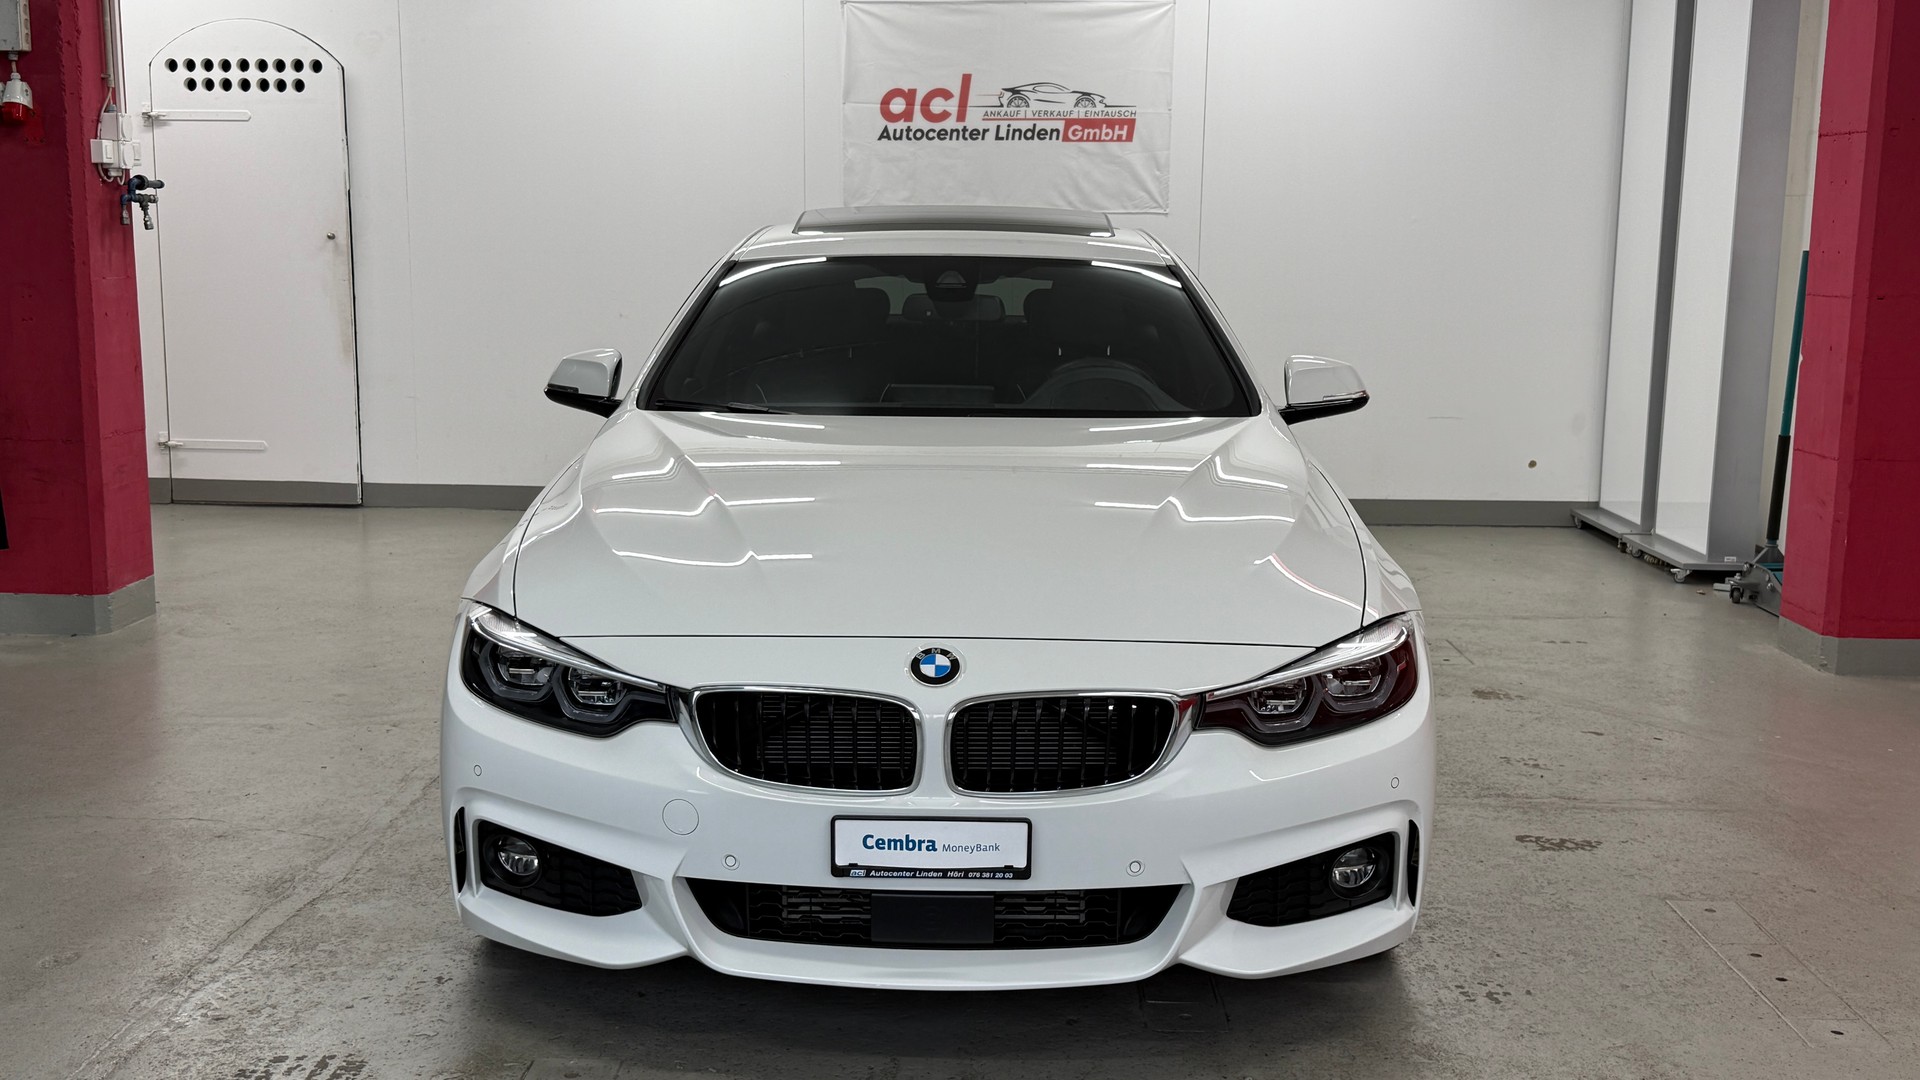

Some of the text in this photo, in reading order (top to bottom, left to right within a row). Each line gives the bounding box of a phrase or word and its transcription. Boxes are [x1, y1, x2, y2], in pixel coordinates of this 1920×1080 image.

[880, 73, 972, 123] acl
[877, 123, 1128, 141] Autocenter Linden GmbH
[916, 648, 957, 660] BMW
[862, 834, 1000, 854] Cembra MoneyBank
